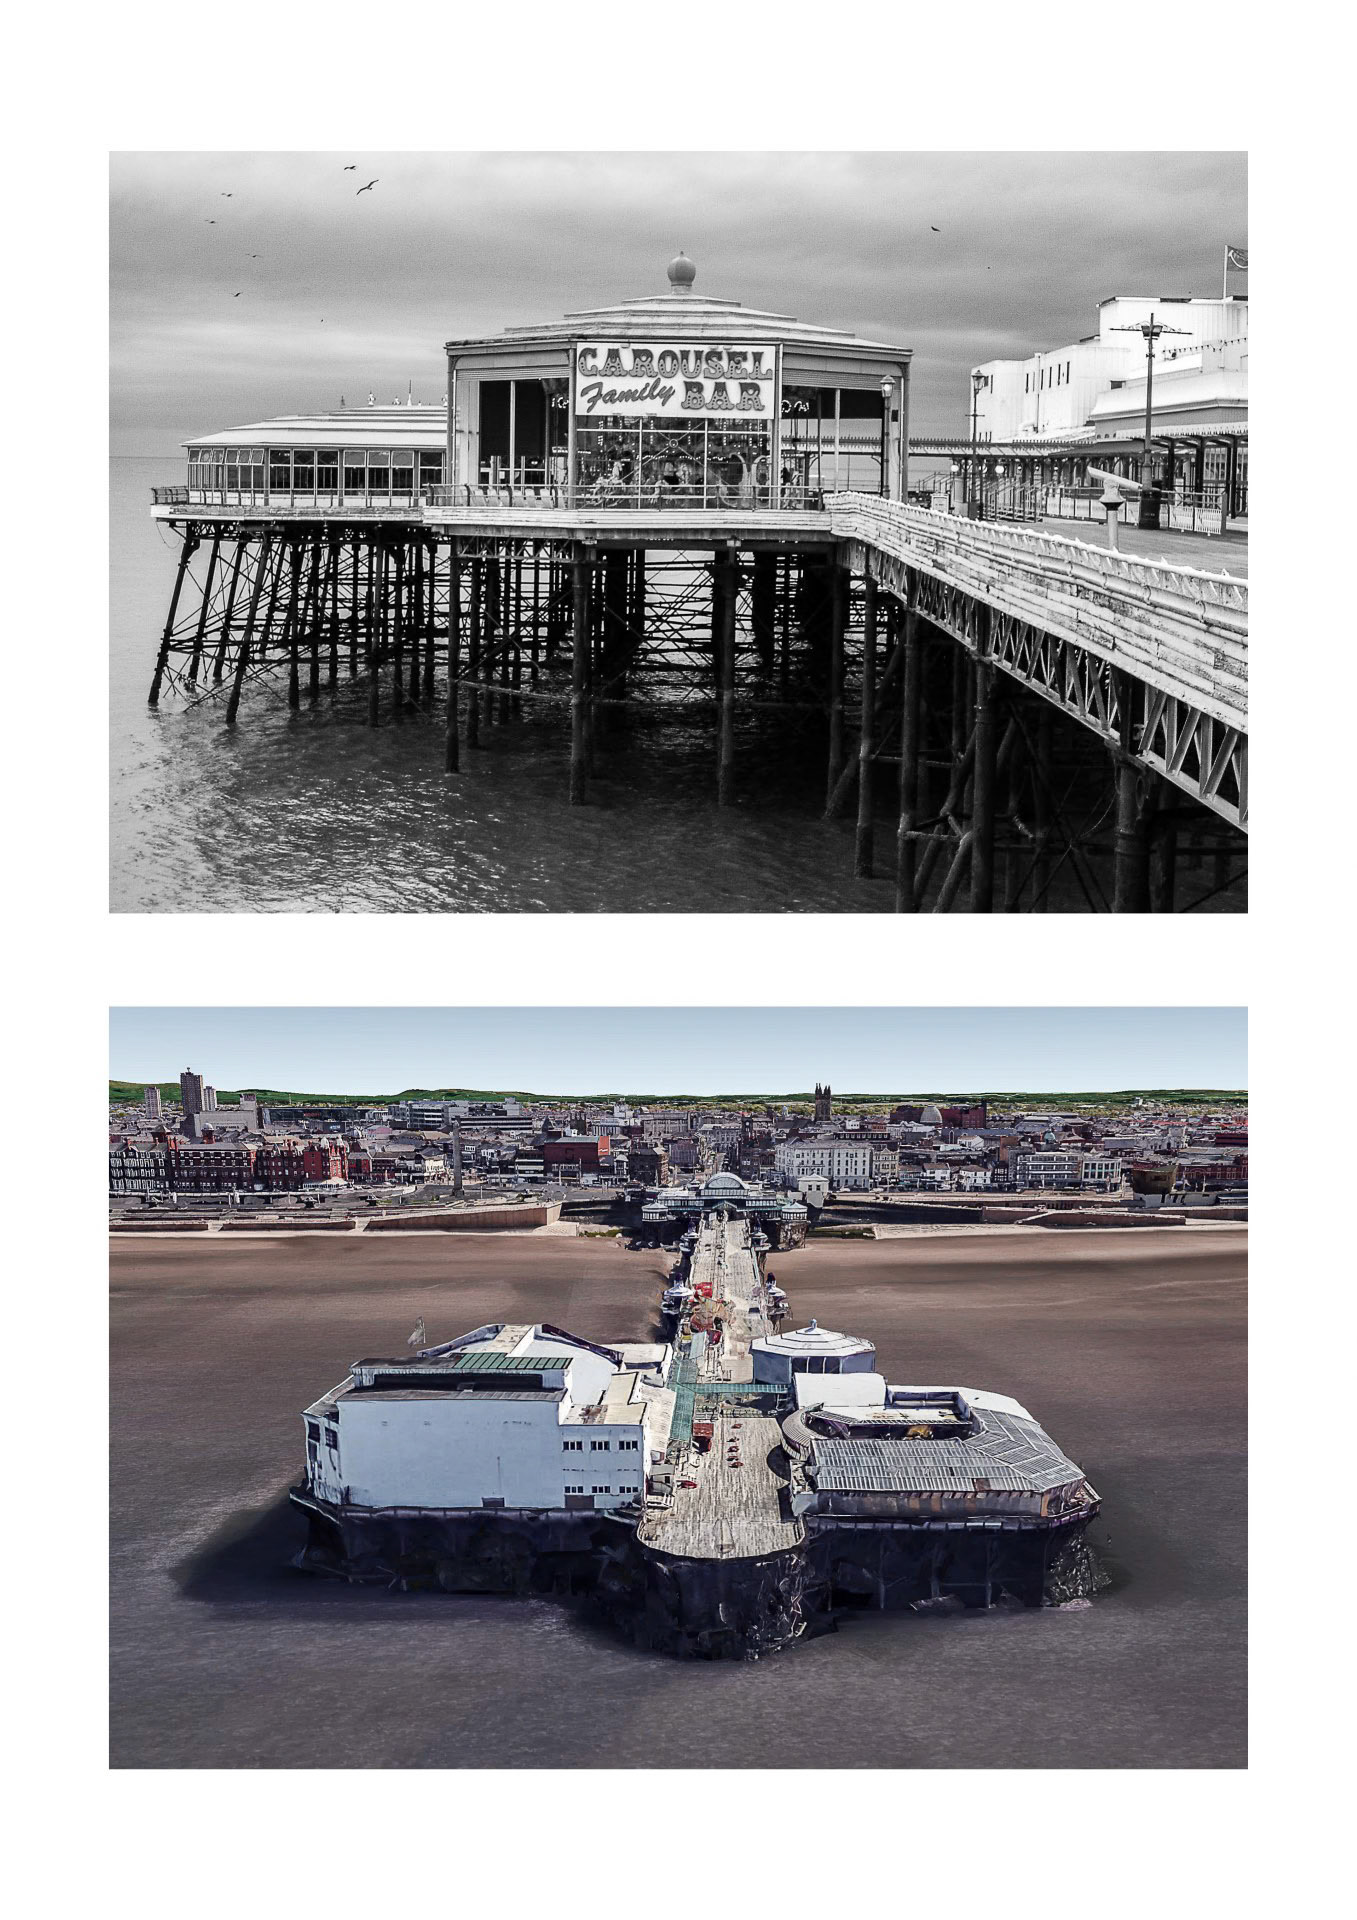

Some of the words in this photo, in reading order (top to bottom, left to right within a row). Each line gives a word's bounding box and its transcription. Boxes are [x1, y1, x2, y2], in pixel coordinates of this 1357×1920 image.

[578, 347, 773, 380] CAROUSEL
[580, 377, 676, 413] Family
[681, 381, 765, 411] BAR
